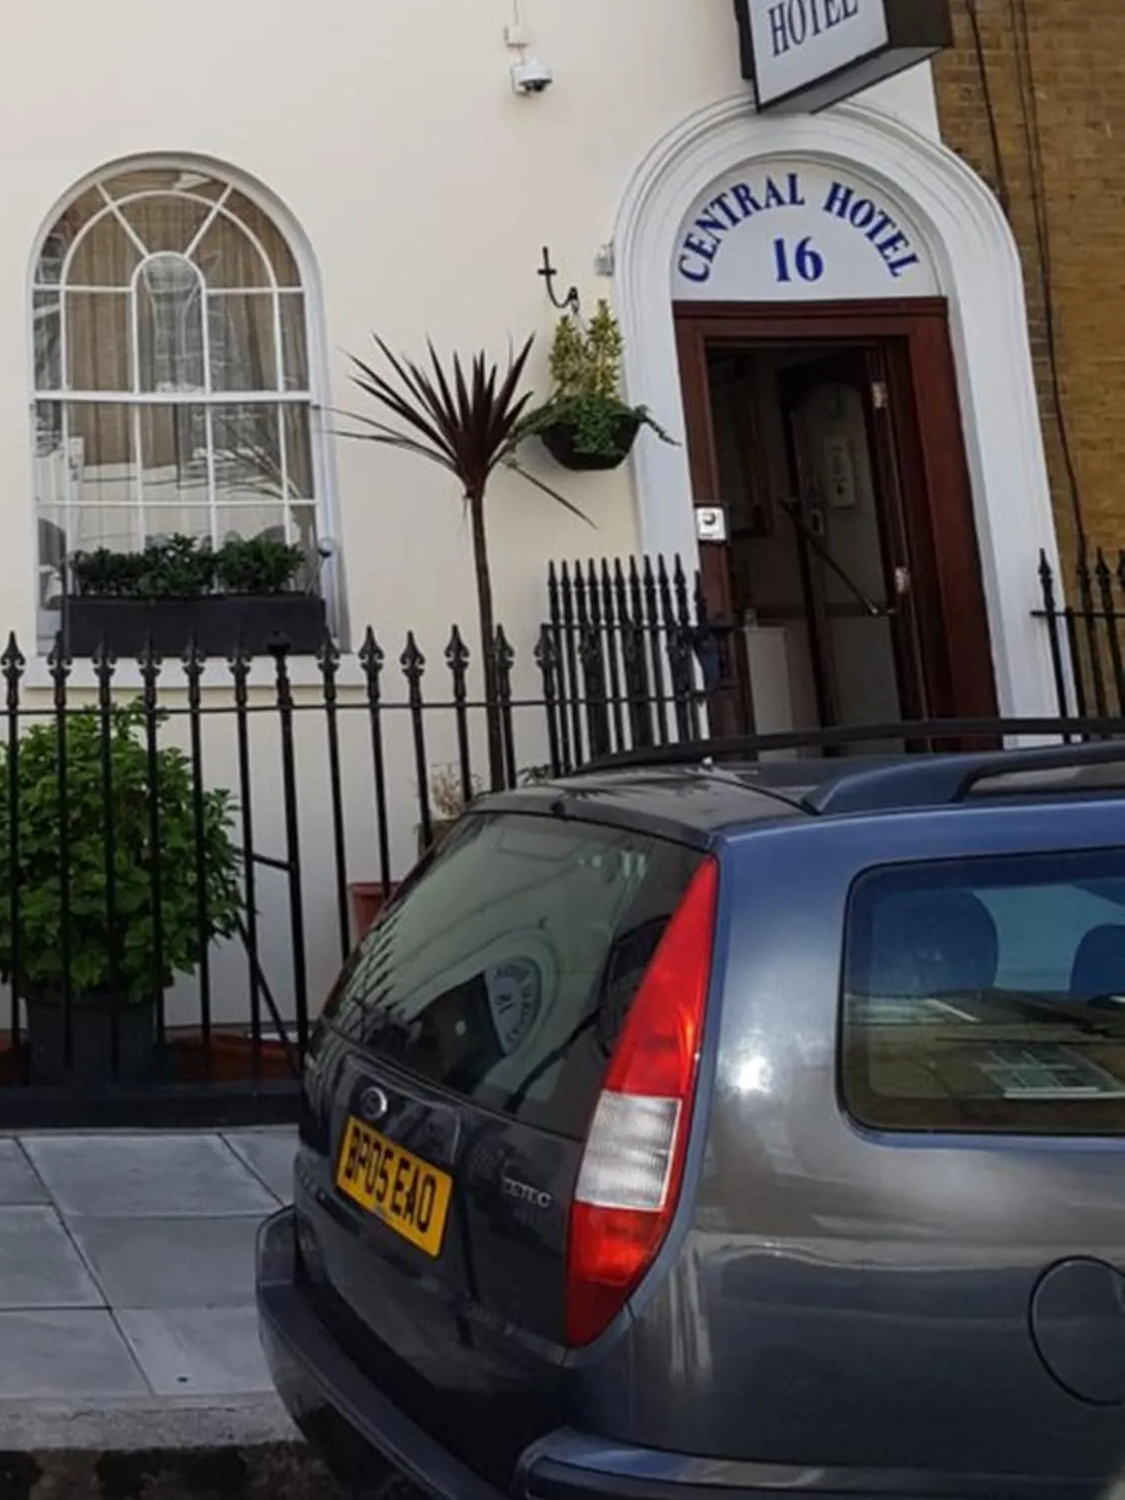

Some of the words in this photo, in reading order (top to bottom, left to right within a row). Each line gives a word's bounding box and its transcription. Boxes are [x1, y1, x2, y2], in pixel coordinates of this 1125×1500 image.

[677, 173, 805, 283] CENTRAL
[822, 181, 920, 278] HOTEL
[773, 236, 823, 282] 16
